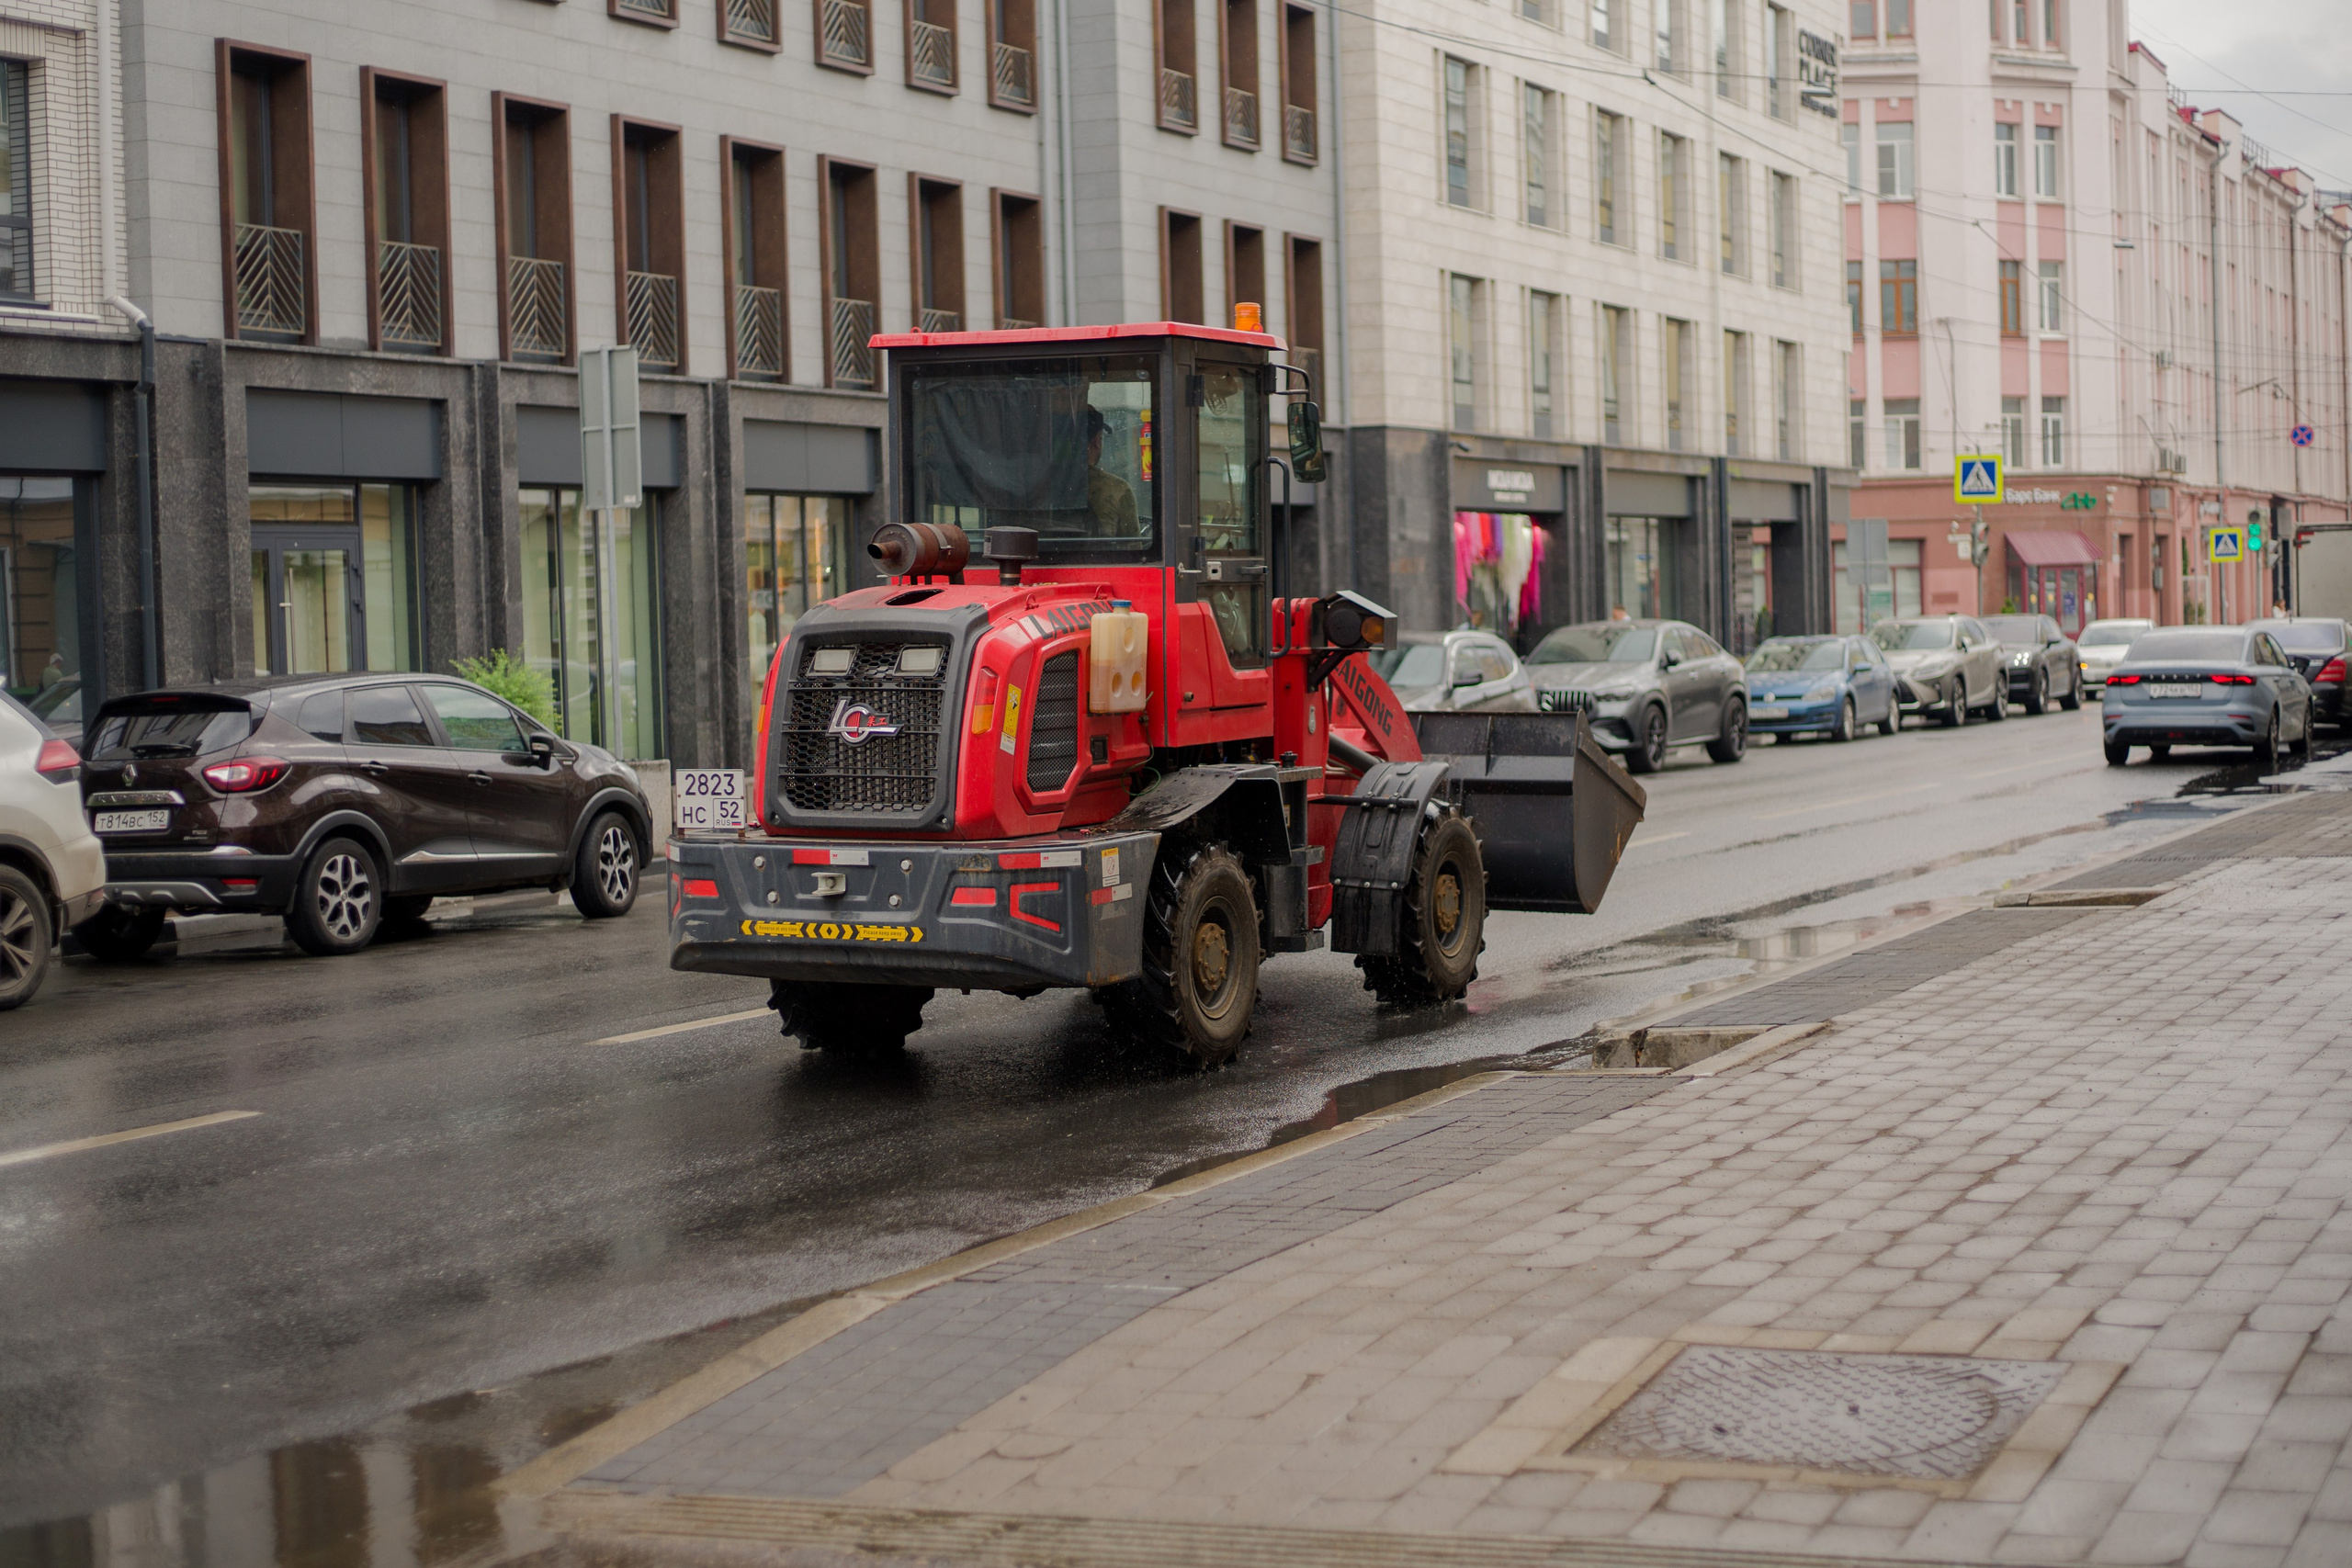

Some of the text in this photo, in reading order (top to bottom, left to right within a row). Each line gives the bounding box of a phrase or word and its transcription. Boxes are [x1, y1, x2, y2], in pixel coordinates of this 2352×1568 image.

[2033, 488, 2061, 504] Банк
[1334, 660, 1393, 738] AIGONG
[684, 773, 735, 795] 2823
[99, 811, 165, 829] Т814ВС 152
[683, 801, 740, 824] НС 52
